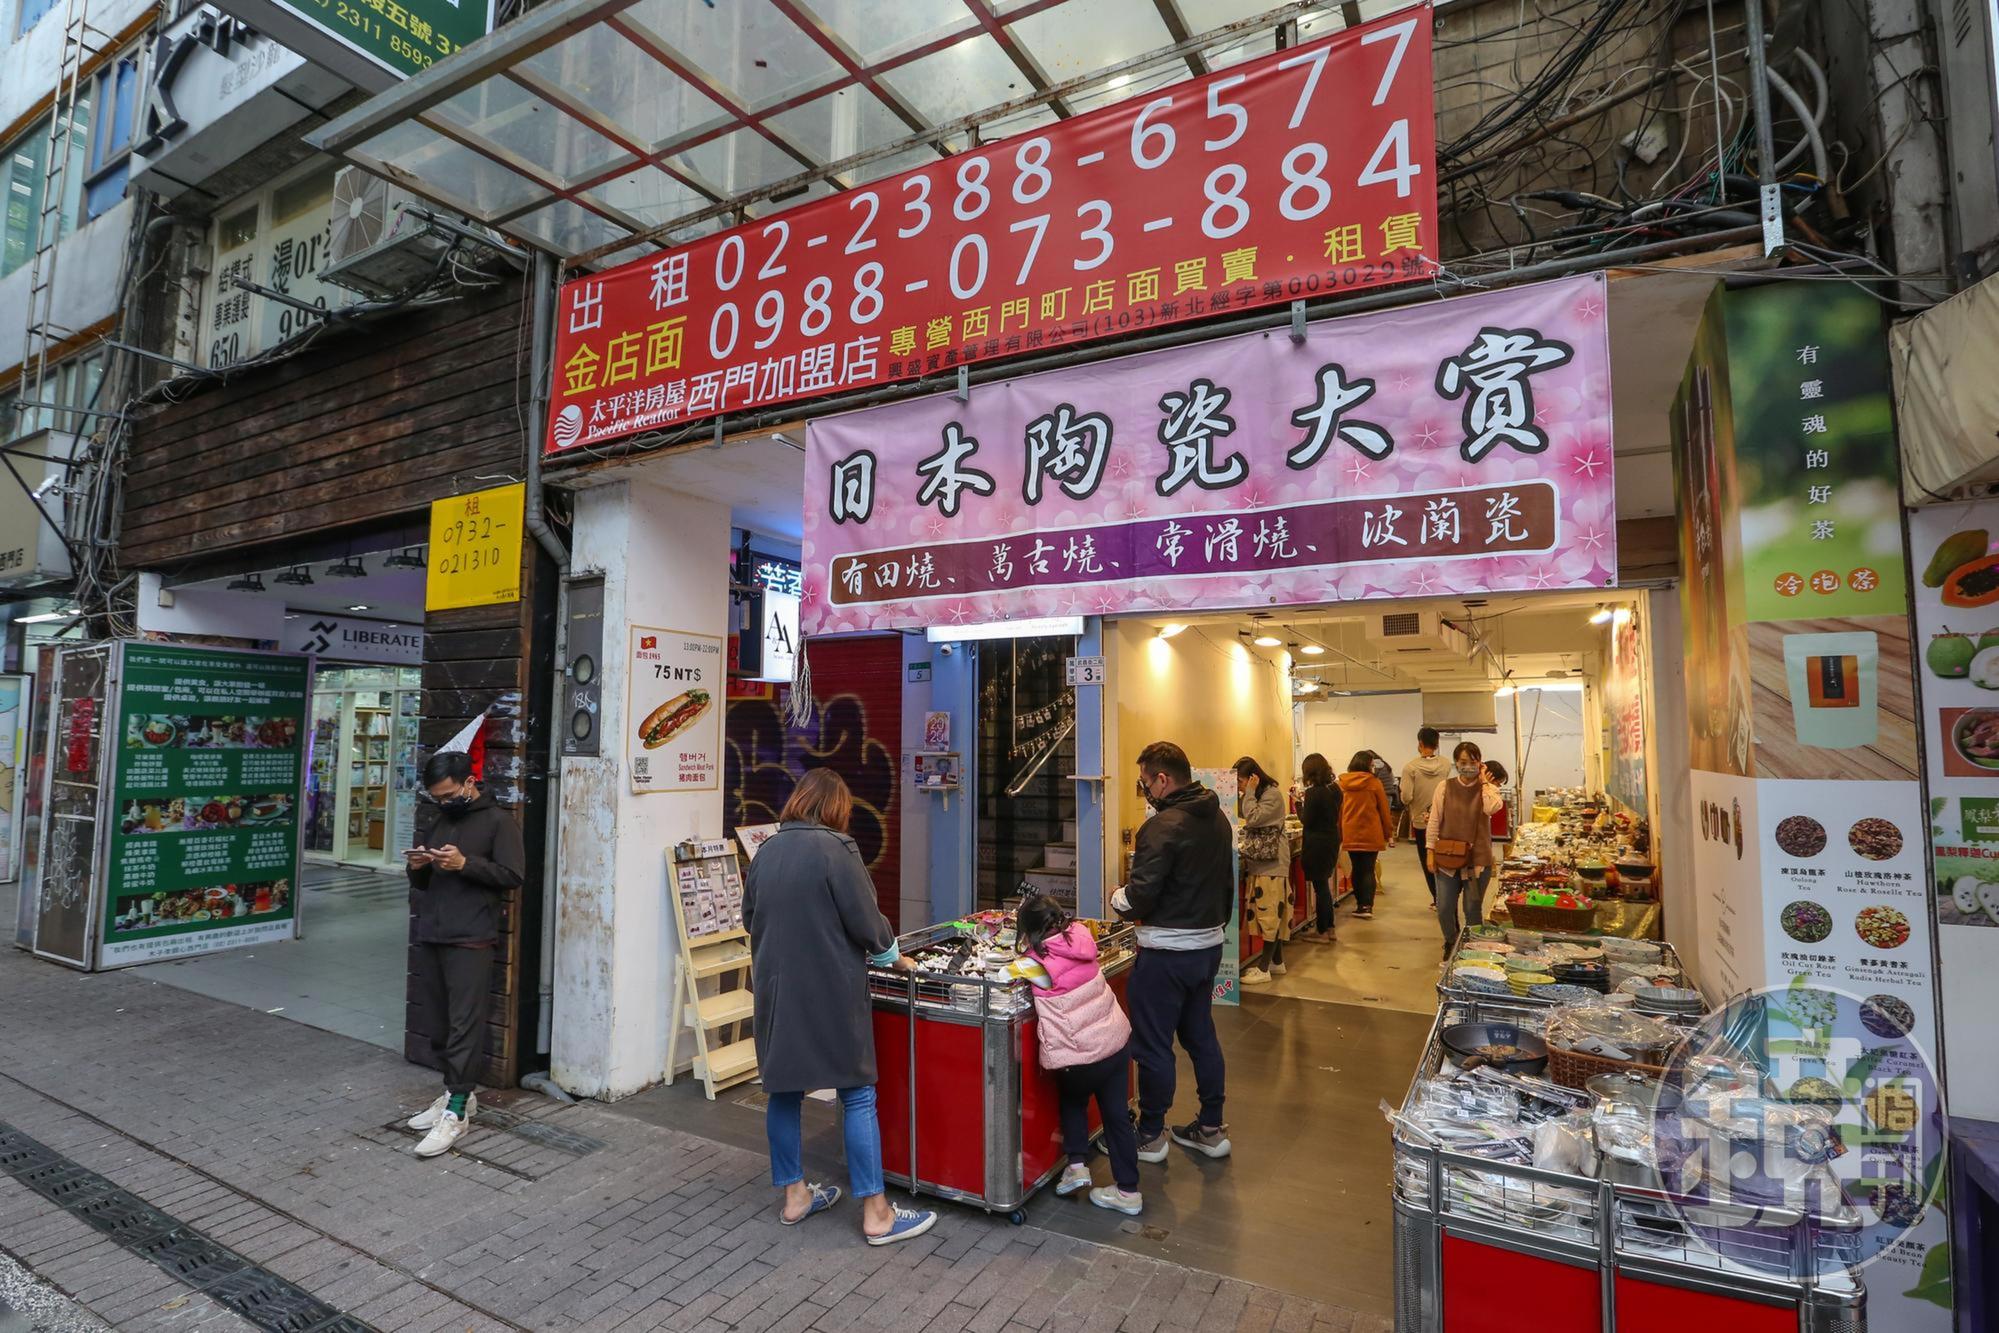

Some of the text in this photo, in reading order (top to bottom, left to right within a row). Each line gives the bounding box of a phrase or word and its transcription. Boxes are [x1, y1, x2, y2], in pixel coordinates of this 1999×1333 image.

[335, 2, 433, 70] 2311 8593
[568, 18, 1418, 335] 出租 02-2388-6577
[563, 118, 1421, 397] 金店面 0988-073-884
[687, 335, 881, 413] 西門加盟店
[589, 378, 687, 424] 太平洋房屋
[587, 407, 681, 440] Pacific Realtor
[829, 327, 1575, 525] 日本陶瓷大賞
[1796, 344, 1835, 542] 有靈魂的好茶
[464, 496, 481, 517] 租
[443, 517, 506, 545] 0932-
[439, 547, 500, 575] 021310
[1776, 569, 1877, 595] 冷泡茶
[342, 629, 420, 648] LIBERATE
[654, 664, 702, 682] 75 NT$
[1084, 667, 1093, 681] 3
[1857, 879, 1901, 888] Hawthorn
[1870, 888, 1902, 896] Roselle
[1816, 970, 1831, 978] Tea
[1875, 977, 1904, 985] Herbal
[1899, 1248, 1923, 1258] Bean
